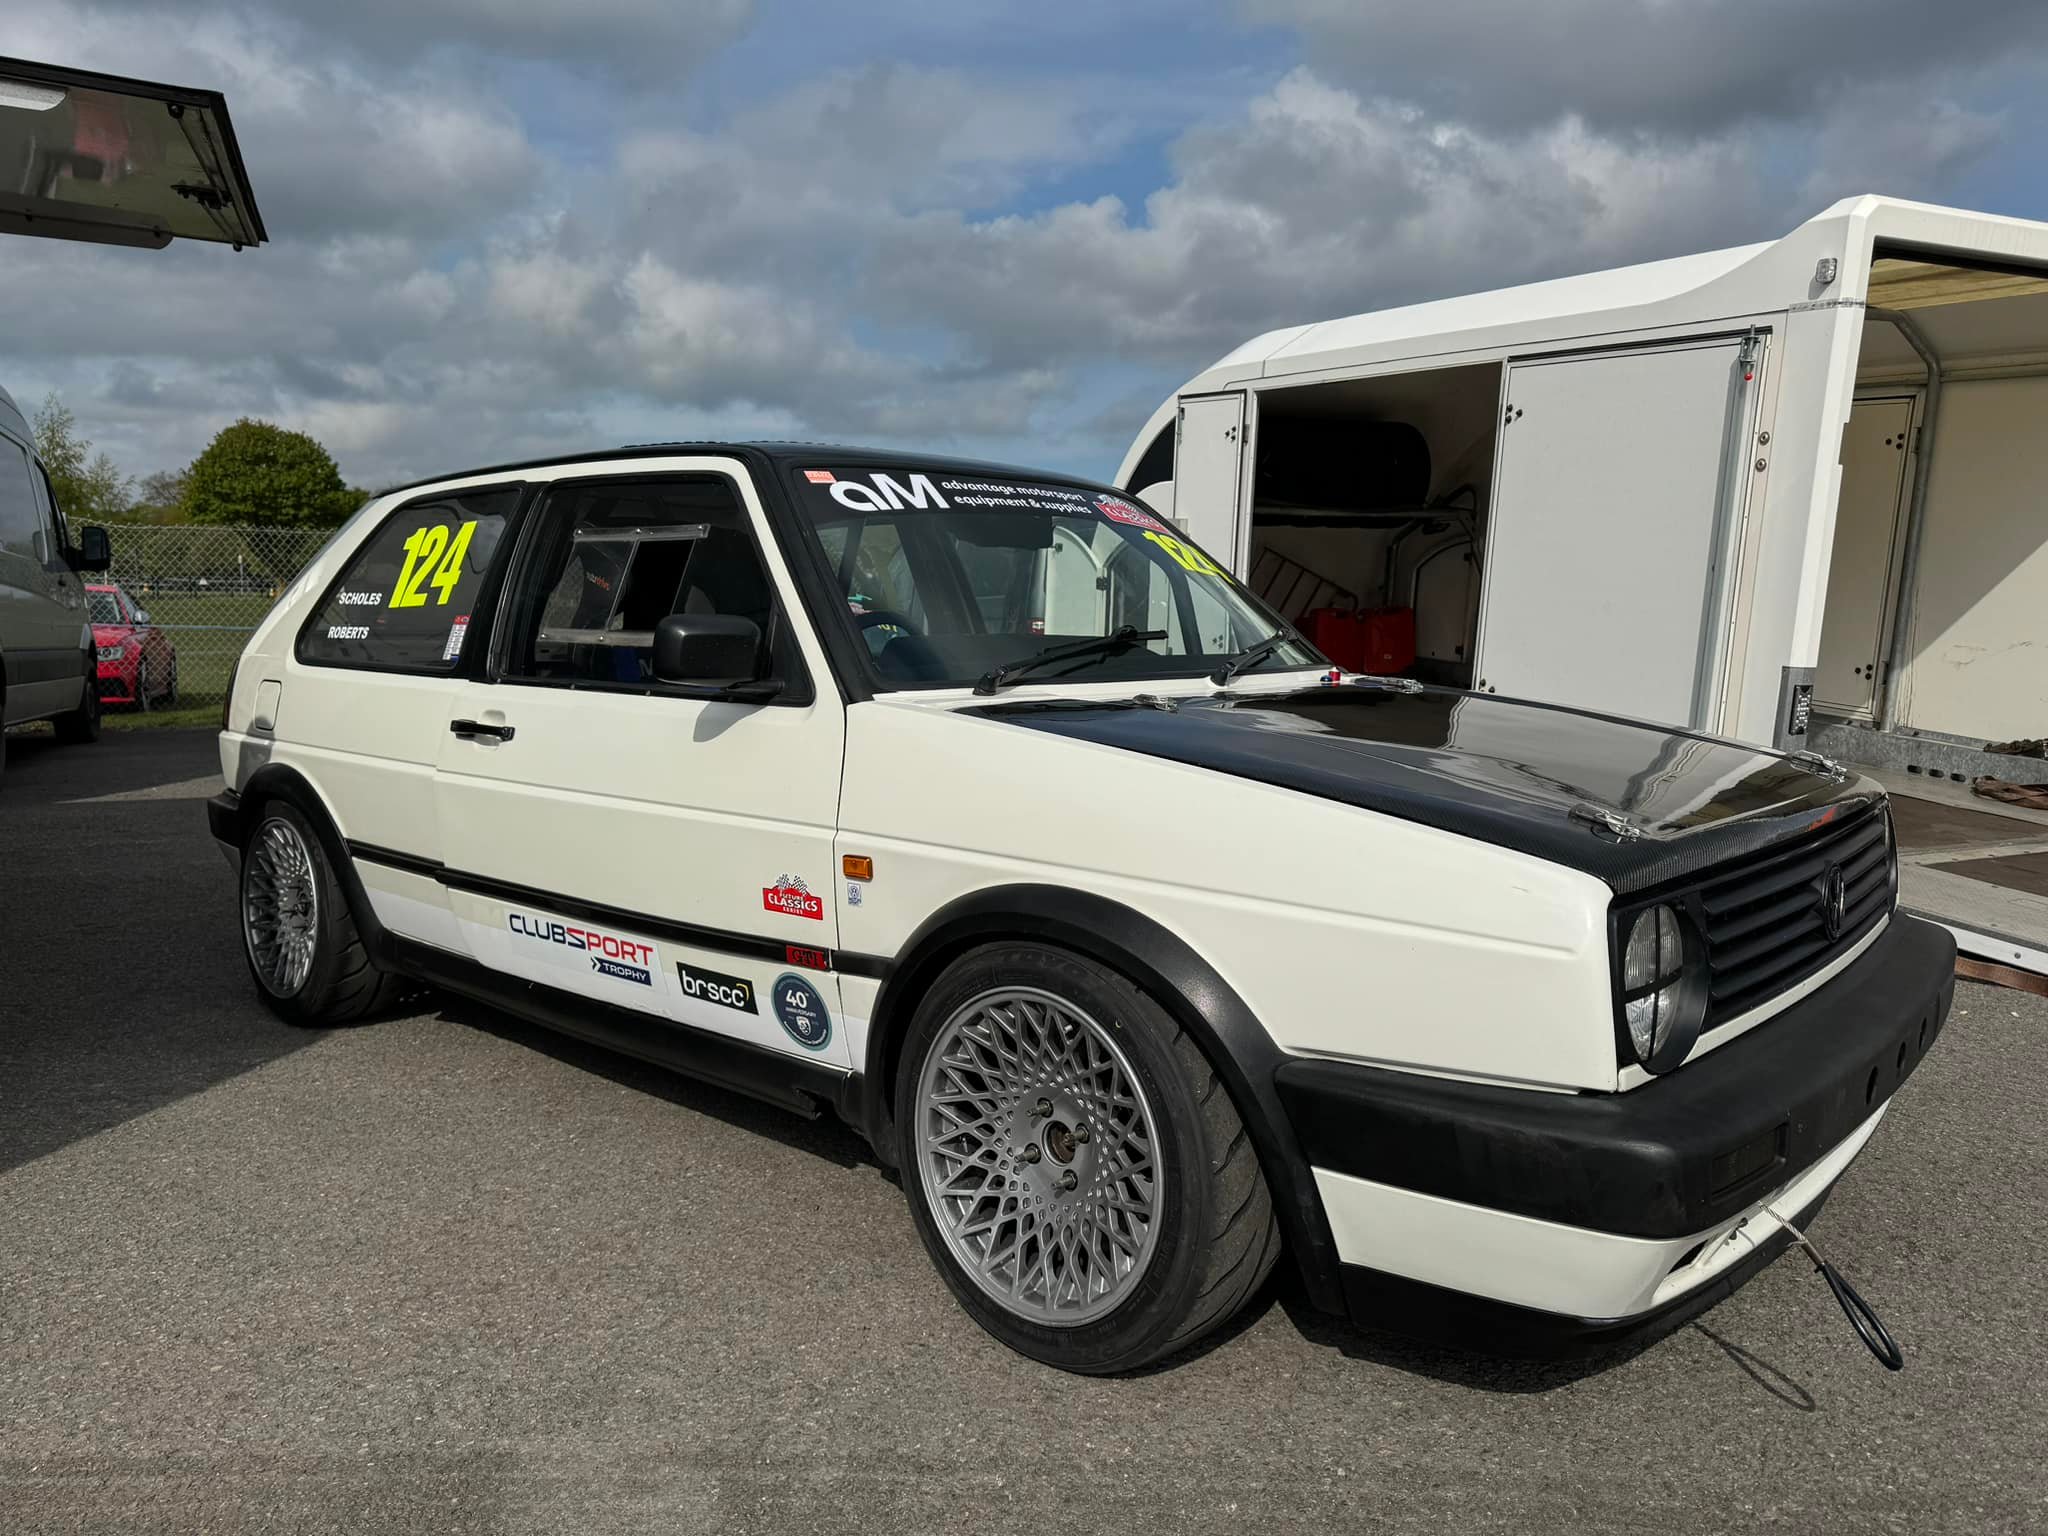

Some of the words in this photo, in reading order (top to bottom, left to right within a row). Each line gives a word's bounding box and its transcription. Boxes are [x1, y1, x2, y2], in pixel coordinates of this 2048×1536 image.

[941, 480, 1016, 495] advantage
[1016, 487, 1087, 502] motorsport
[954, 494, 1030, 507] equipment
[1029, 498, 1042, 508] &
[1041, 501, 1092, 514] supplies
[388, 520, 478, 608] 124
[339, 592, 382, 605] SCHOLES
[327, 626, 370, 639] ROBERTS
[768, 893, 818, 911] CLASSICS
[509, 914, 653, 966] CLUBSPORT
[602, 962, 647, 981] TROPHY
[682, 970, 745, 1007] brscc
